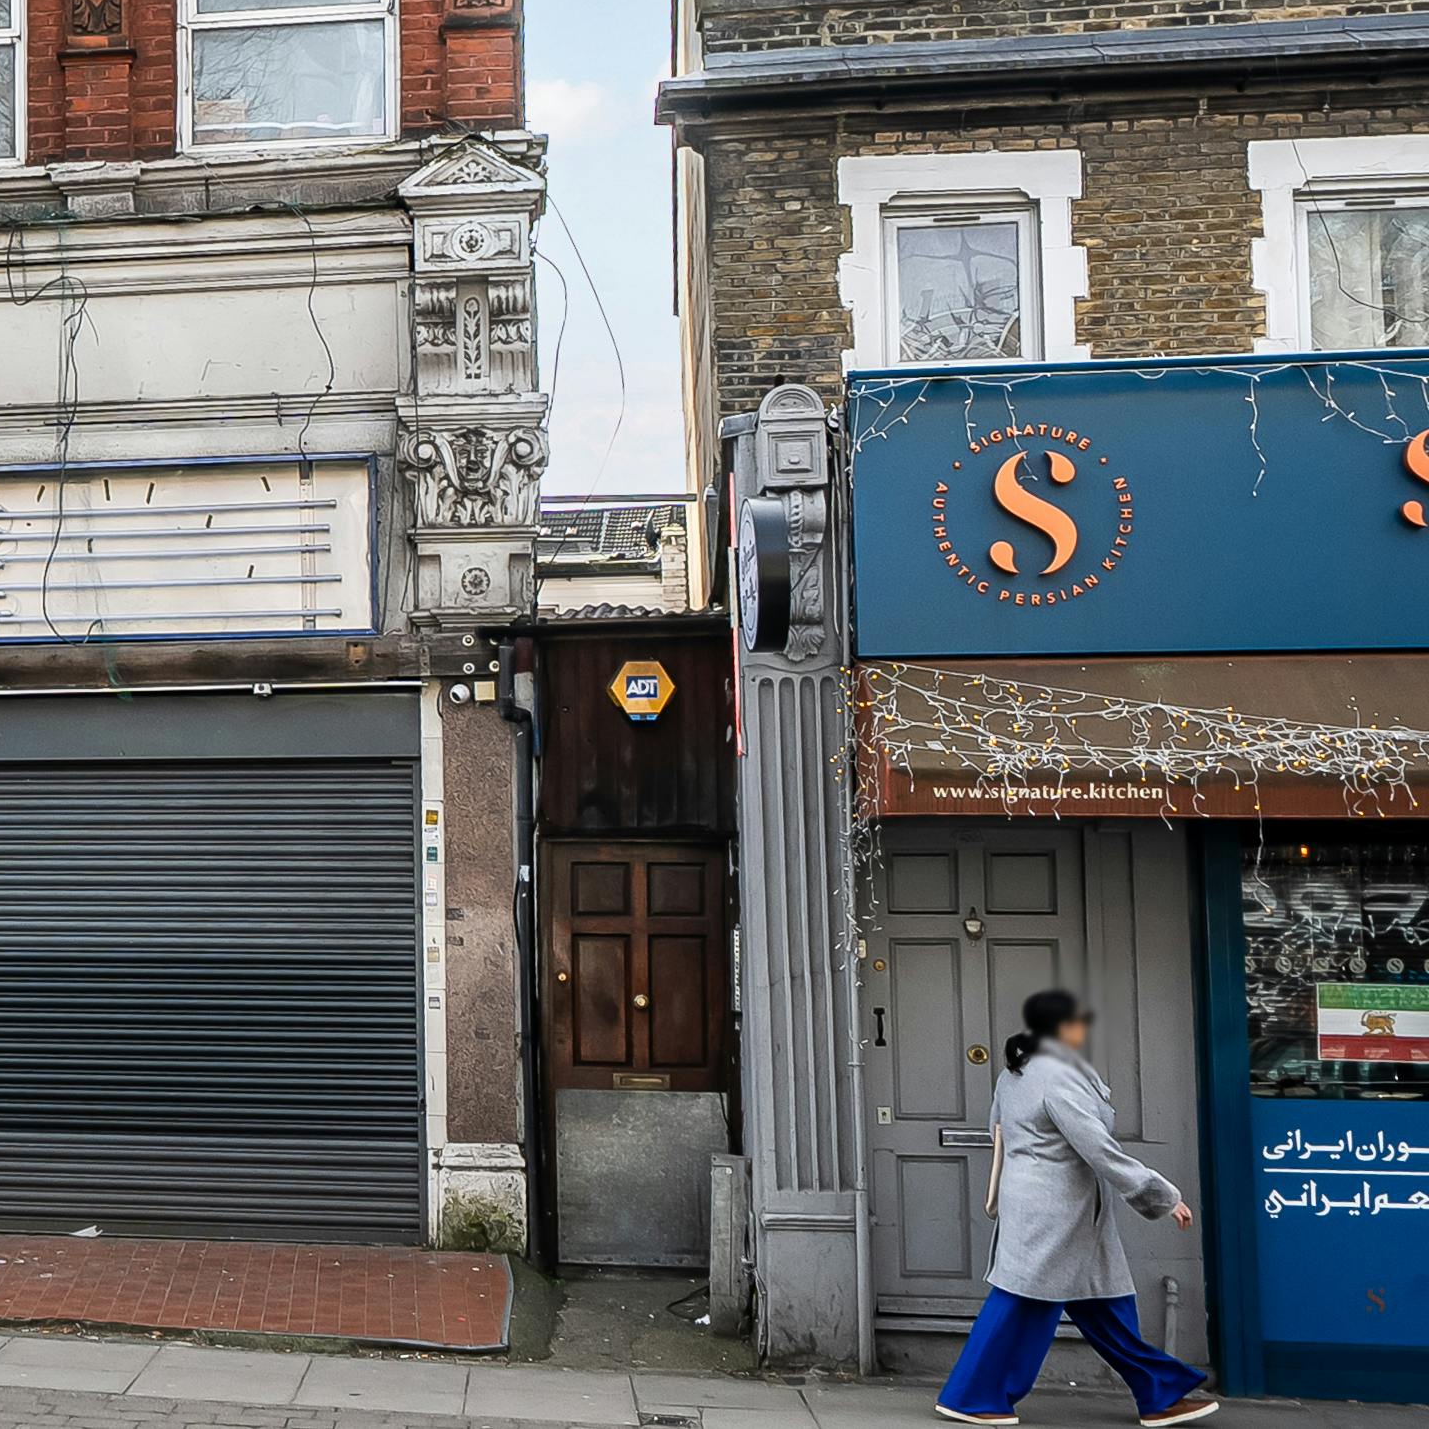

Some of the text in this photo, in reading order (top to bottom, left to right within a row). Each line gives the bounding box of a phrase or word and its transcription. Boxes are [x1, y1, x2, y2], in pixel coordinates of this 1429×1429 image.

[969, 424, 1092, 454] SIGNATURE
[989, 449, 1078, 575] S
[932, 476, 1134, 606] AUTHENTIC PERSIAN KITCHEN
[626, 678, 659, 696] ADT
[933, 783, 1164, 803] www.signature.kitchen
[1355, 1130, 1429, 1162] وران
